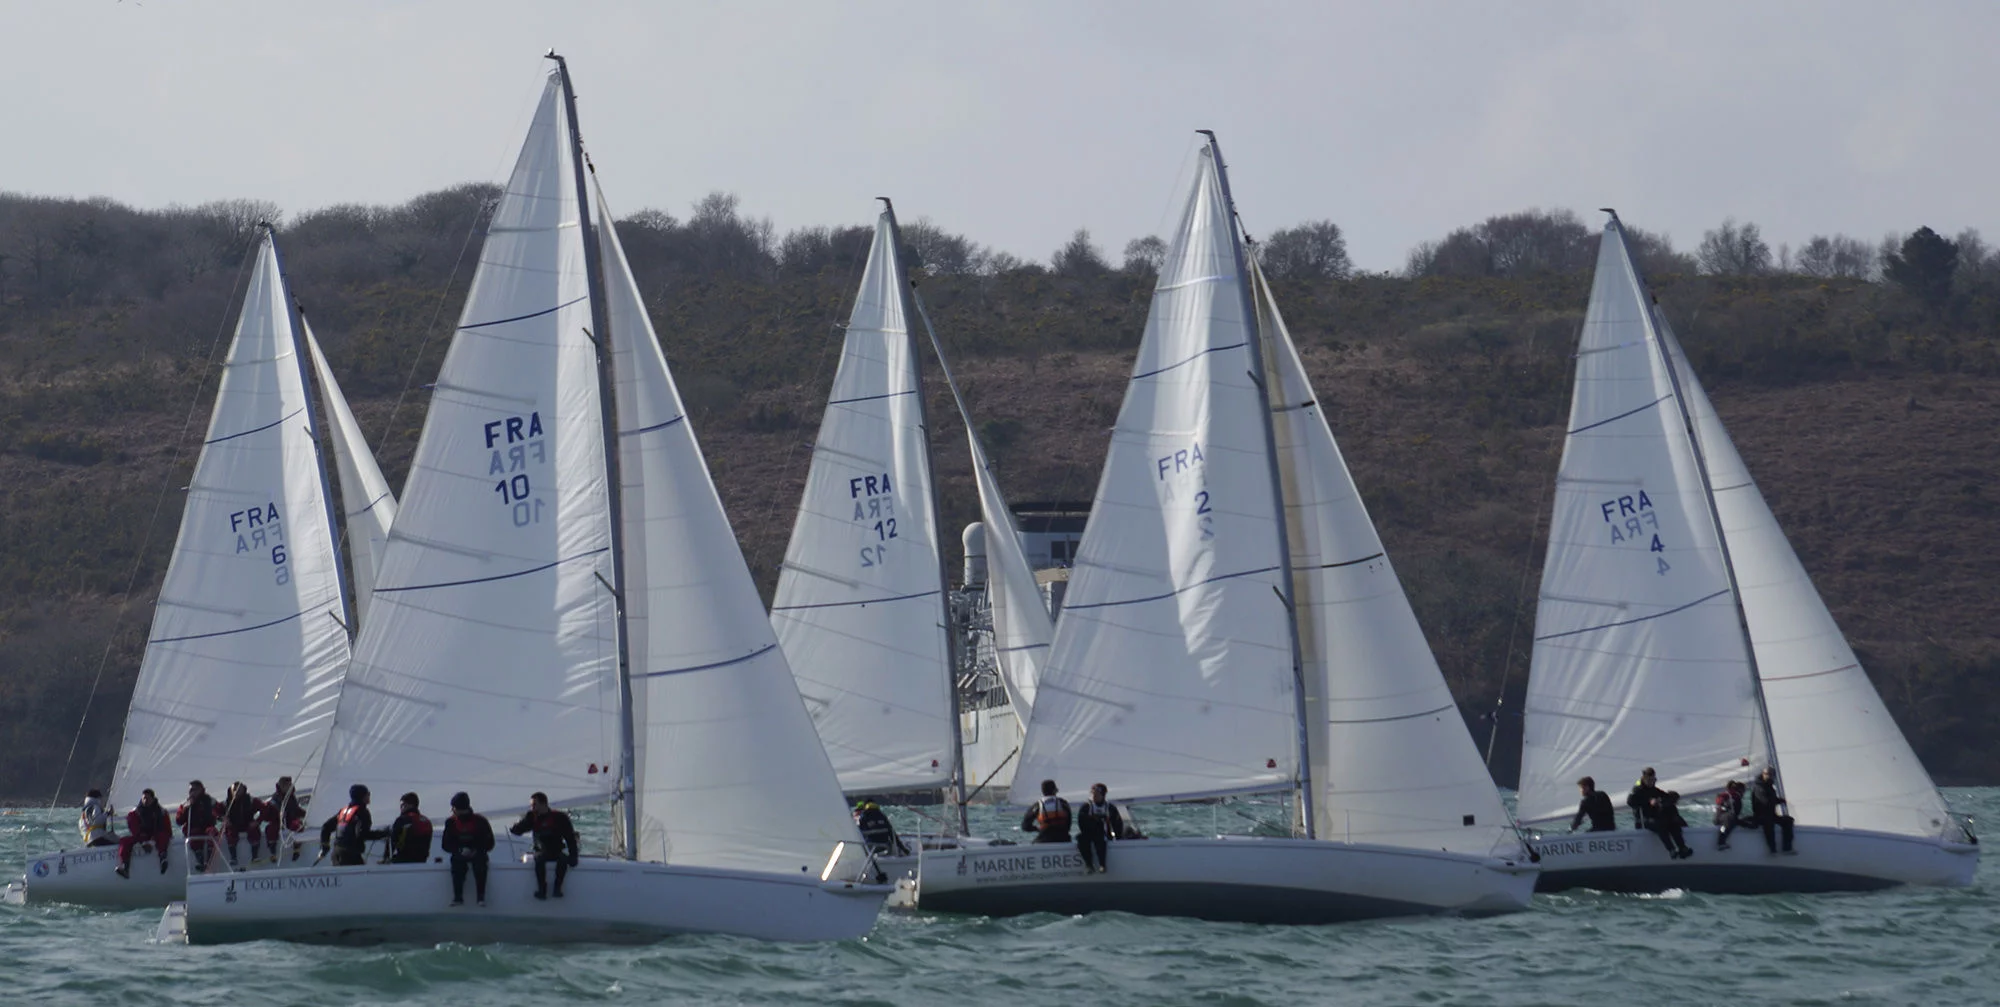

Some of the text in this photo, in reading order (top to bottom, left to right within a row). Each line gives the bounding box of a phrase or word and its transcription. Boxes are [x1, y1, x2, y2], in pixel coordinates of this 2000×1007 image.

[484, 411, 543, 449] FRA
[1158, 442, 1204, 481] FRA
[495, 474, 530, 505] 10
[850, 473, 892, 499] FRA
[1194, 490, 1212, 515] 2
[1601, 489, 1653, 523] FRA
[230, 501, 280, 533] FRA
[874, 518, 898, 541] 12
[272, 544, 286, 565] 6
[1650, 533, 1666, 553] 4
[1588, 840, 1632, 853] BREST
[974, 857, 1036, 873] MARINE
[1041, 855, 1084, 869] BRES
[245, 877, 341, 891] ECOLE NAVALE
